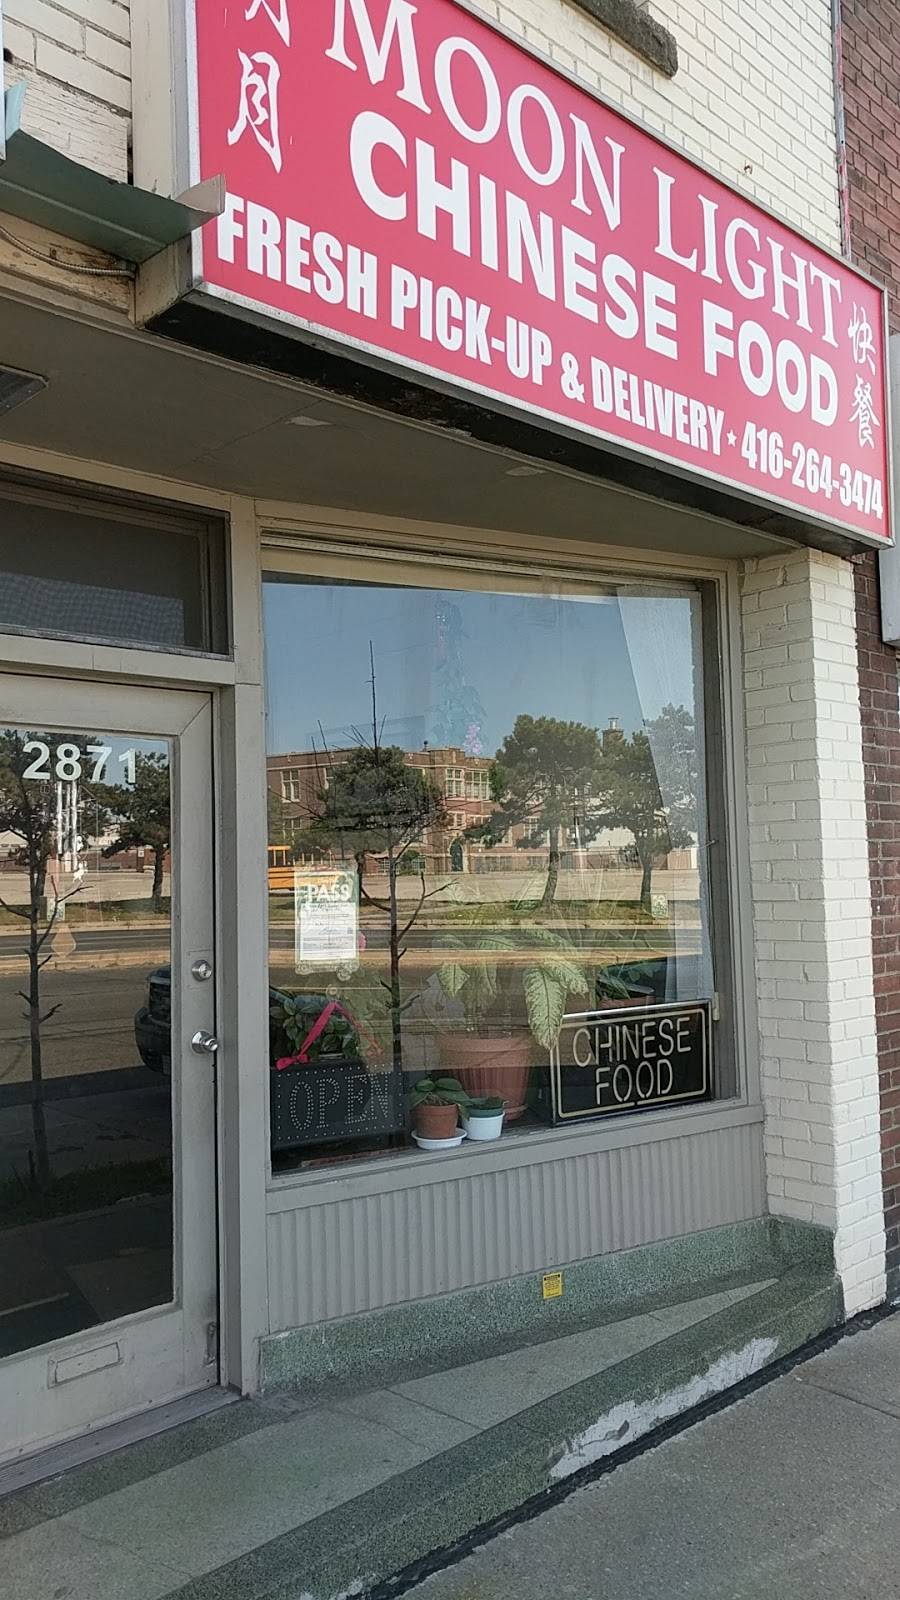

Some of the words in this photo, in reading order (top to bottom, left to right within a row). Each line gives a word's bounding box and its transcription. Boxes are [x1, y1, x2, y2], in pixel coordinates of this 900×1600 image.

[325, 0, 626, 232] MOON
[653, 166, 842, 348] LIGHT
[350, 111, 679, 361] CHINESE
[702, 299, 839, 427] FOOD
[216, 190, 378, 321] FRESH
[391, 263, 553, 386] PICK-UP
[560, 351, 586, 404] &
[591, 356, 725, 456] DELIVERY
[741, 421, 883, 520] 416-264-3474
[22, 741, 136, 784] 2871
[572, 1017, 692, 1068] CHINESE
[290, 1071, 391, 1131] OPEN
[595, 1069, 674, 1105] FOOD
